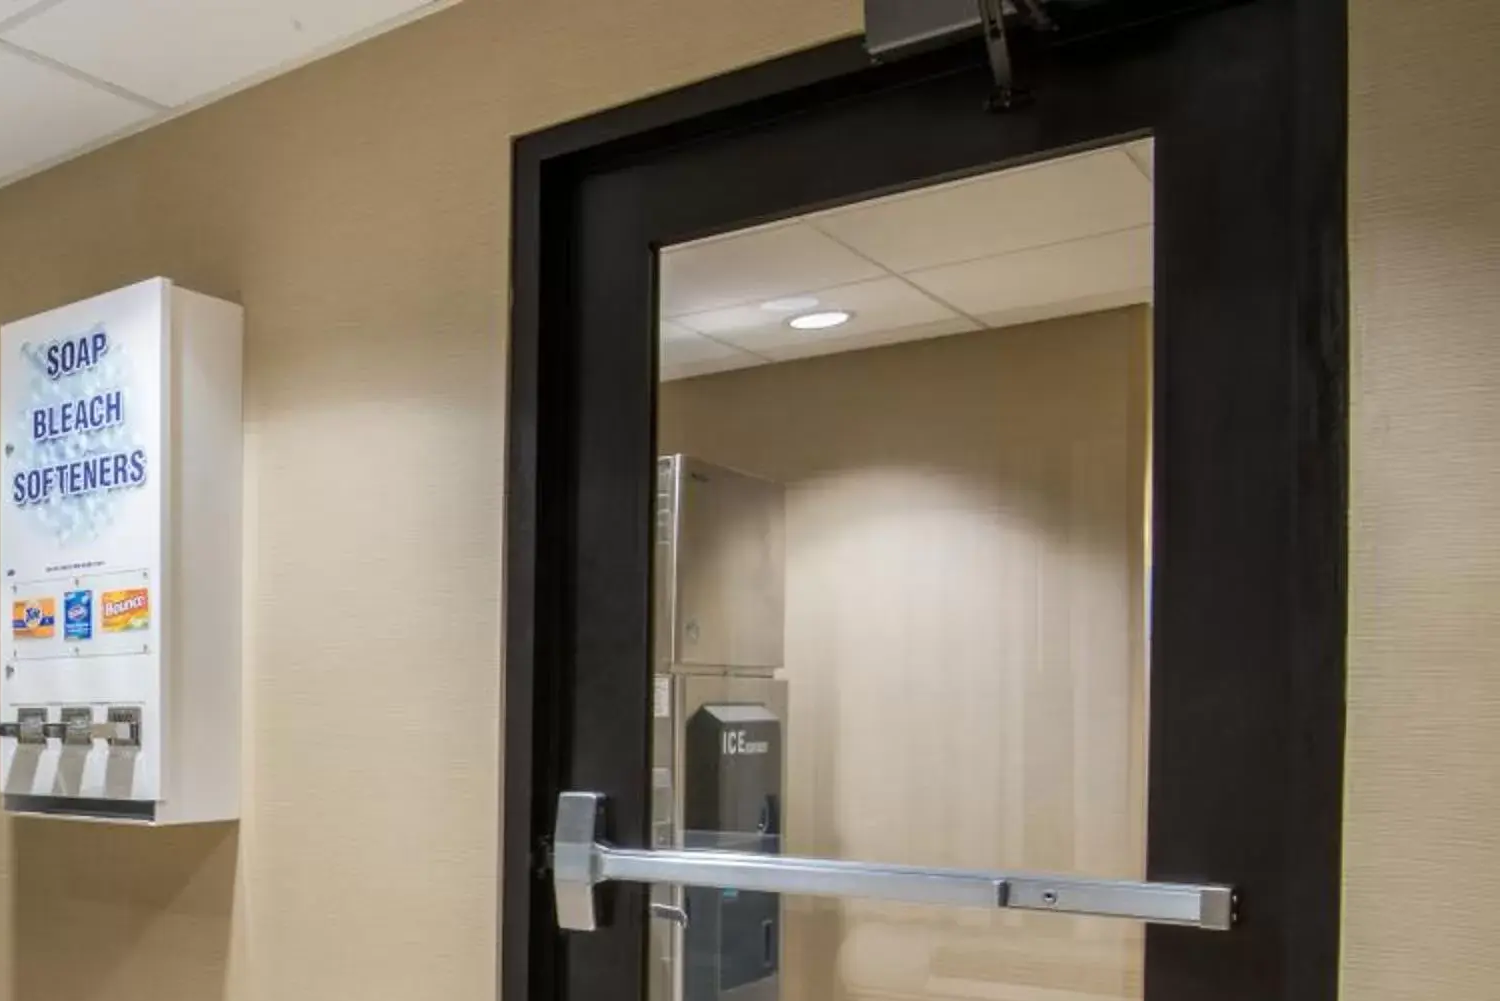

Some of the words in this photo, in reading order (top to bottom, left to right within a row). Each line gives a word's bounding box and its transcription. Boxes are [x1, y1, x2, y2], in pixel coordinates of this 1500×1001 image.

[47, 333, 107, 376] SOAP
[33, 391, 121, 438] BLEACH
[13, 450, 145, 502] SOFTENERS
[723, 731, 745, 754] ICE
